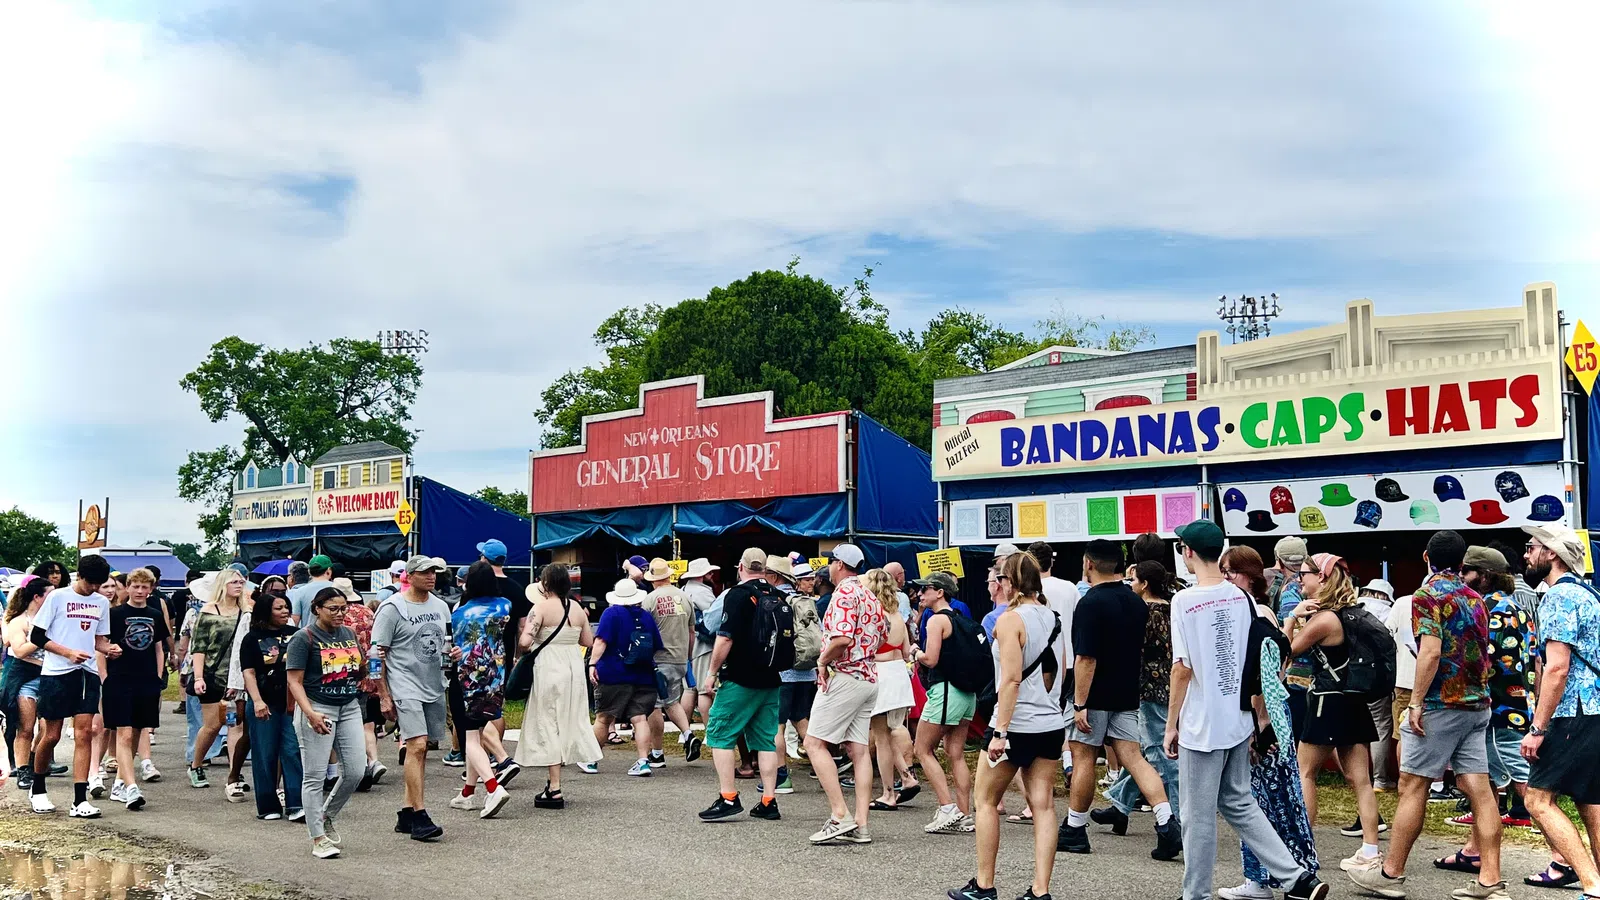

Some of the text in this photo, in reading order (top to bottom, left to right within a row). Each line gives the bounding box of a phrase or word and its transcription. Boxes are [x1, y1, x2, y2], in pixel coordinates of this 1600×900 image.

[1572, 342, 1597, 372] E5
[1000, 374, 1540, 467] BANDANAS CAPS HATS
[624, 422, 719, 447] NEW ORLEANS
[944, 426, 972, 452] Official
[577, 441, 780, 488] GENERAL STORE
[945, 438, 980, 470] Jazz Fest
[251, 500, 279, 520] PRALINES
[282, 498, 307, 518] COOKIES
[335, 490, 399, 513] WELCOME BACK!
[398, 510, 411, 525] E5
[656, 595, 673, 604] OLD
[409, 612, 441, 625] SANTORINI
[657, 608, 676, 617] RULE
[318, 640, 357, 649] EAGLES
[320, 686, 347, 694] TOUR
